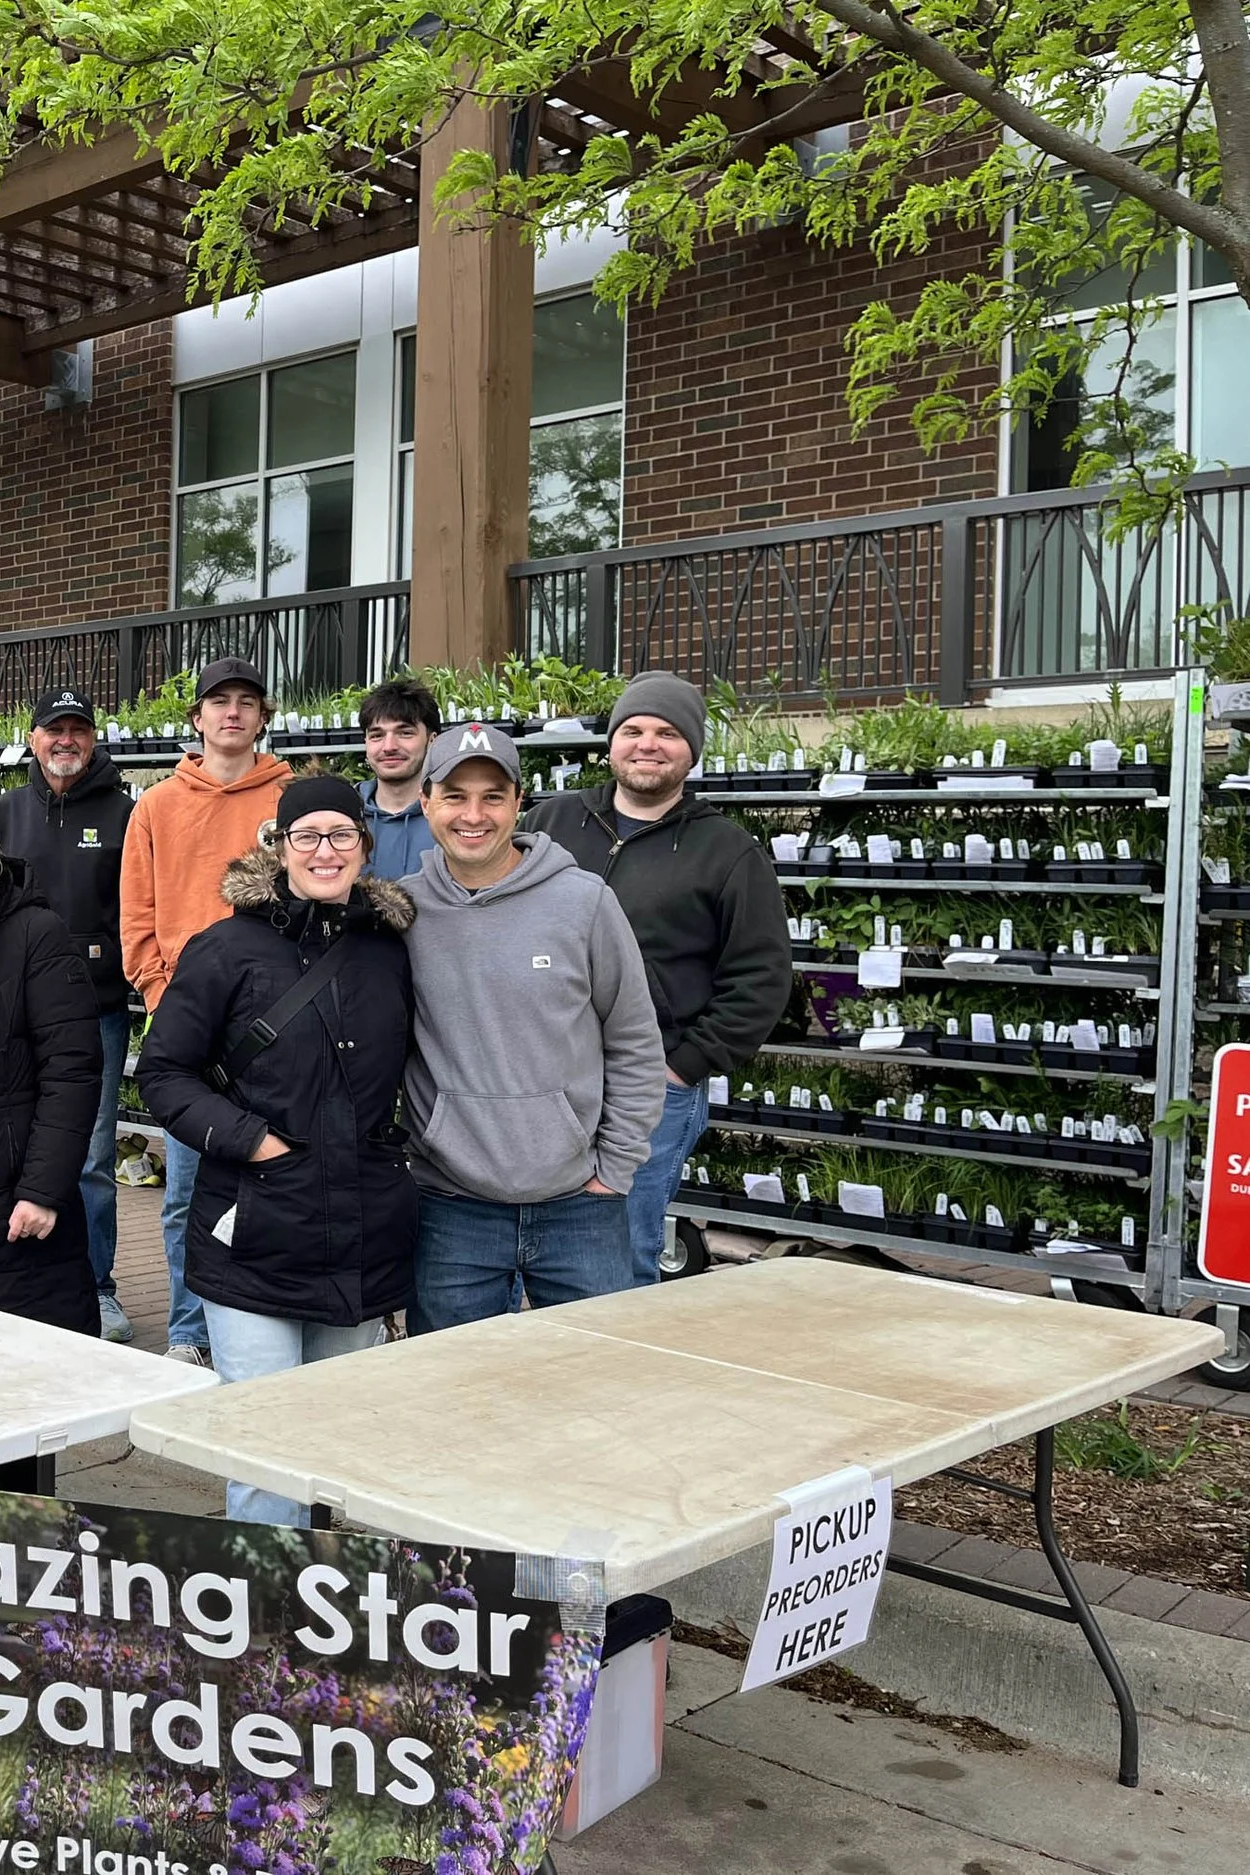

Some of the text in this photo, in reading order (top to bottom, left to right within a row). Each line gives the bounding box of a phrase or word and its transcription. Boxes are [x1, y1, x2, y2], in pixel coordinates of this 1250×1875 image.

[52, 700, 84, 708] ACURA
[458, 731, 493, 752] M
[789, 1497, 877, 1565] PICKUP
[763, 1549, 884, 1622] PREORDERS
[294, 1564, 531, 1678] Star
[775, 1608, 849, 1672] HERE
